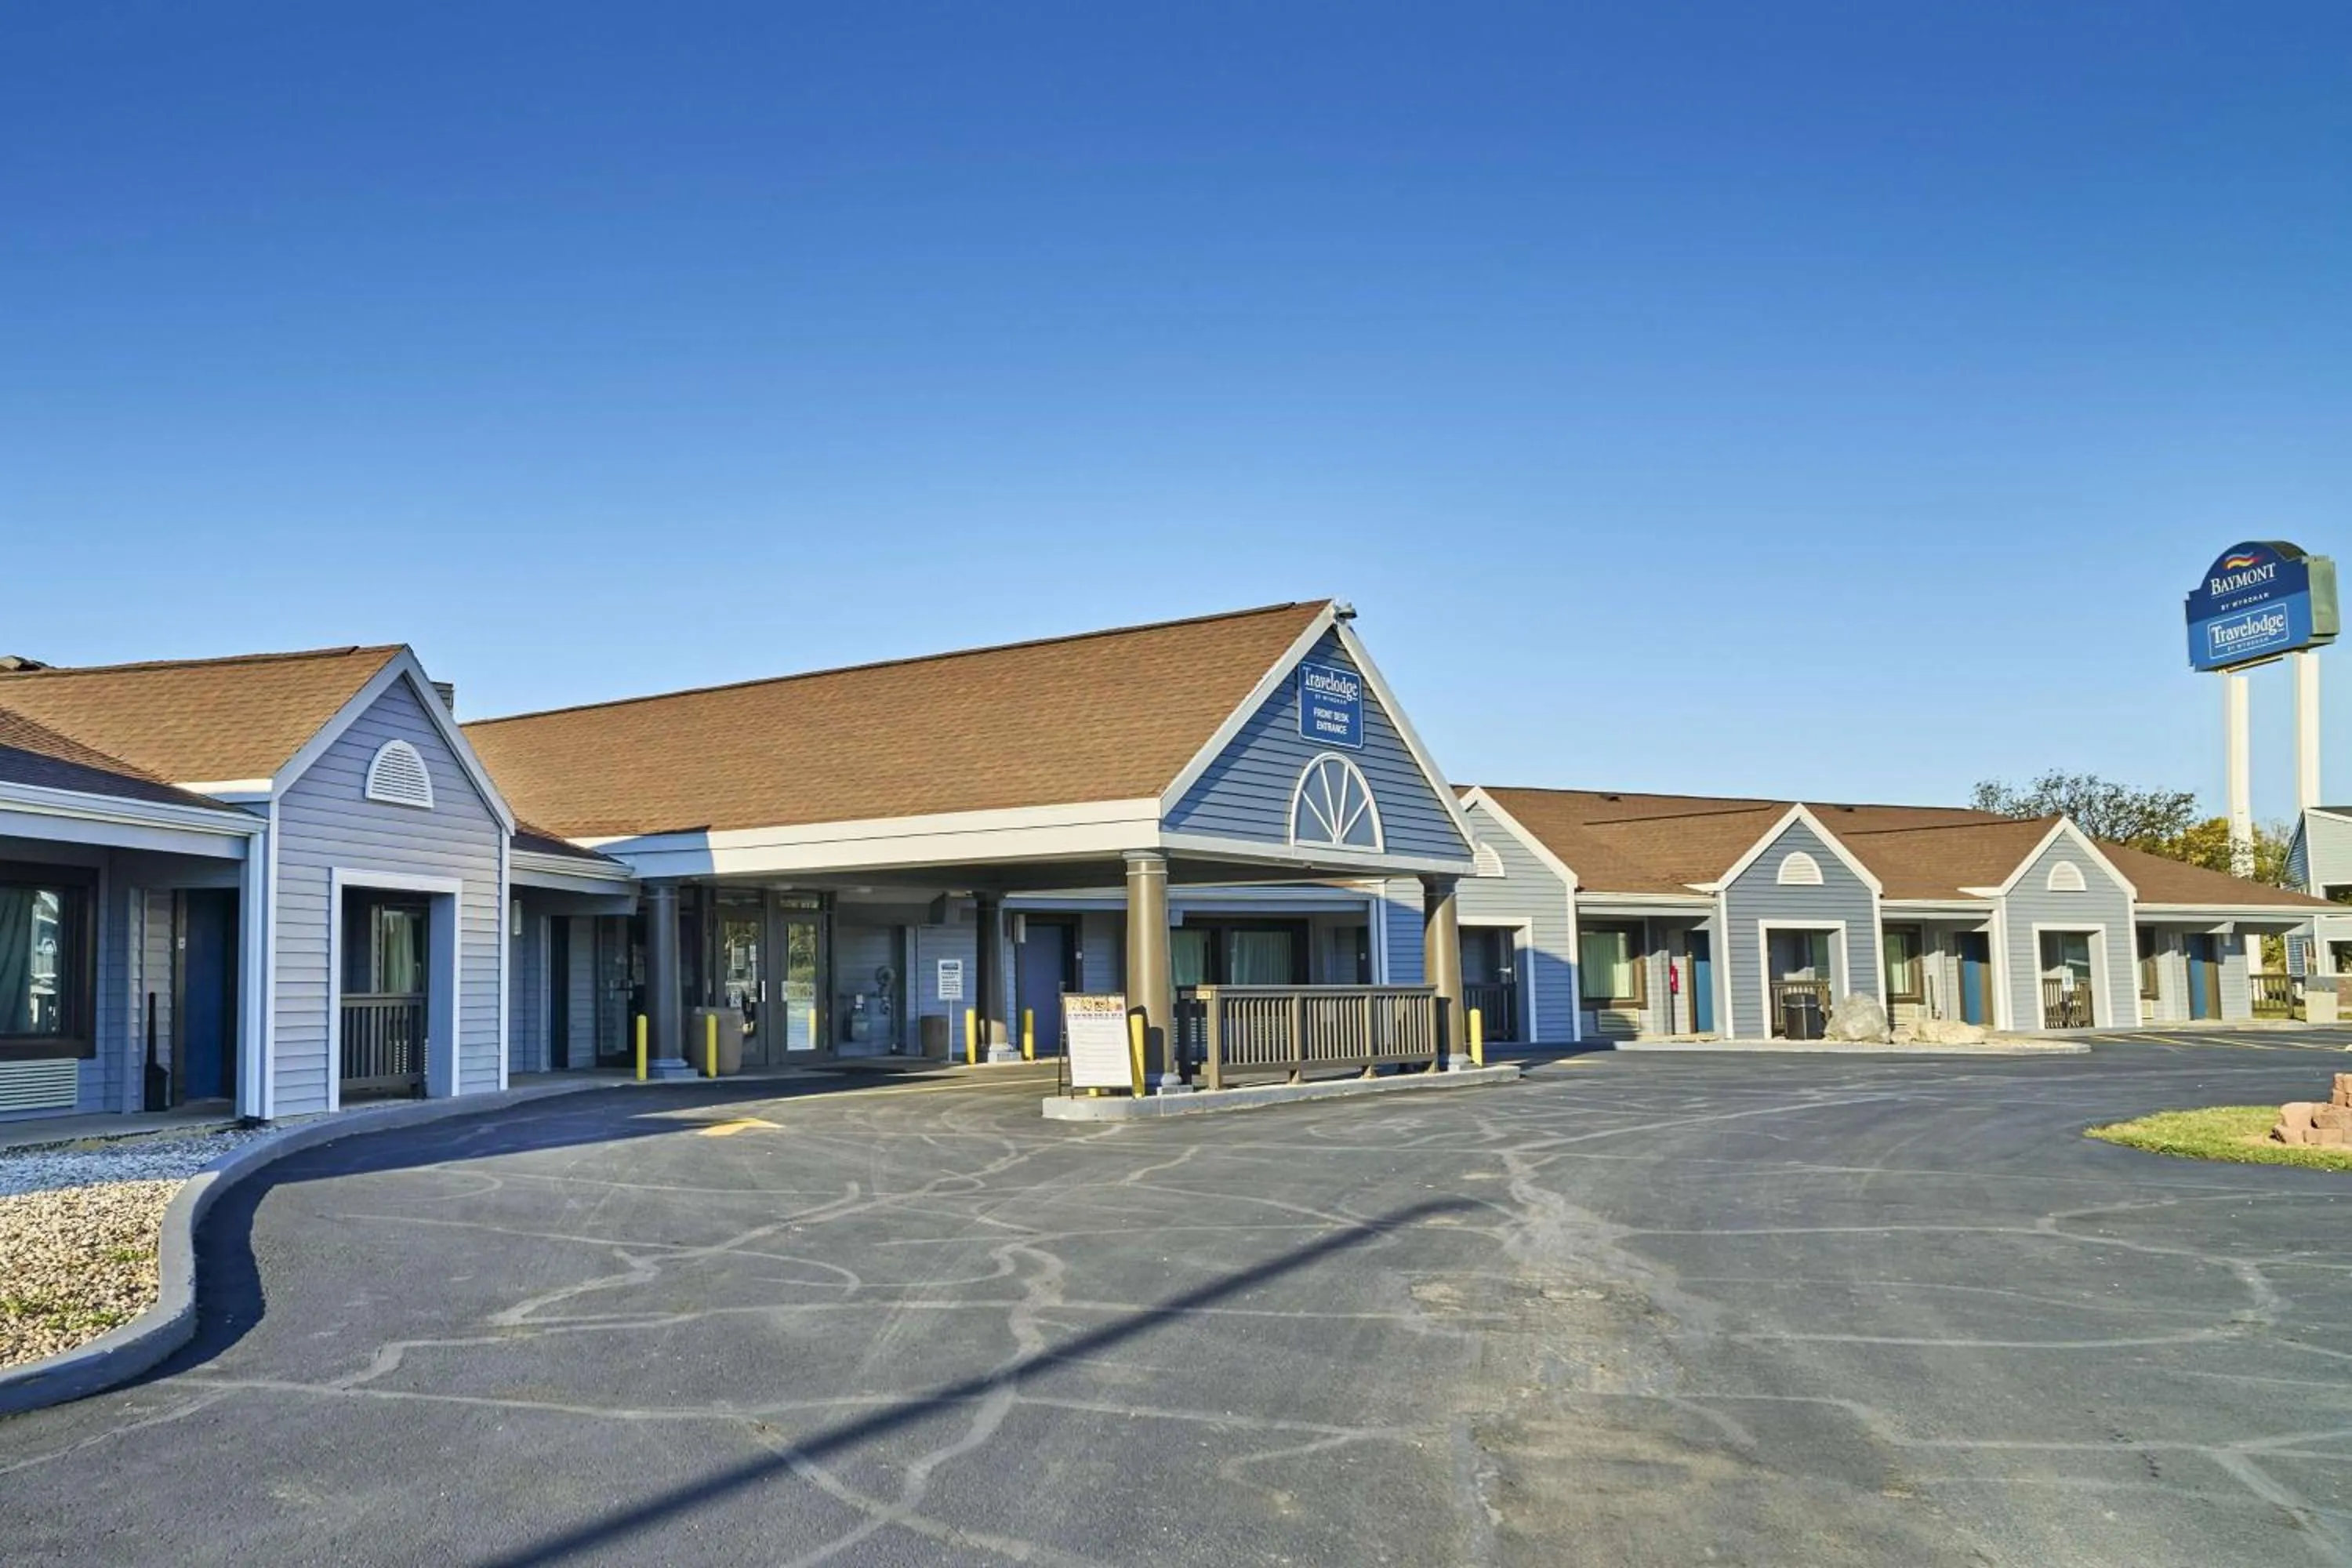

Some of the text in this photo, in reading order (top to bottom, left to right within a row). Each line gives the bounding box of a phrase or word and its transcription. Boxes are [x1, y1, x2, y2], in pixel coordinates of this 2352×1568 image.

[2210, 563, 2275, 595] BAYMONT
[2211, 614, 2284, 644] Travelodge
[1303, 666, 1359, 702] Travelodge
[1316, 720, 1348, 735] ENTRANCE
